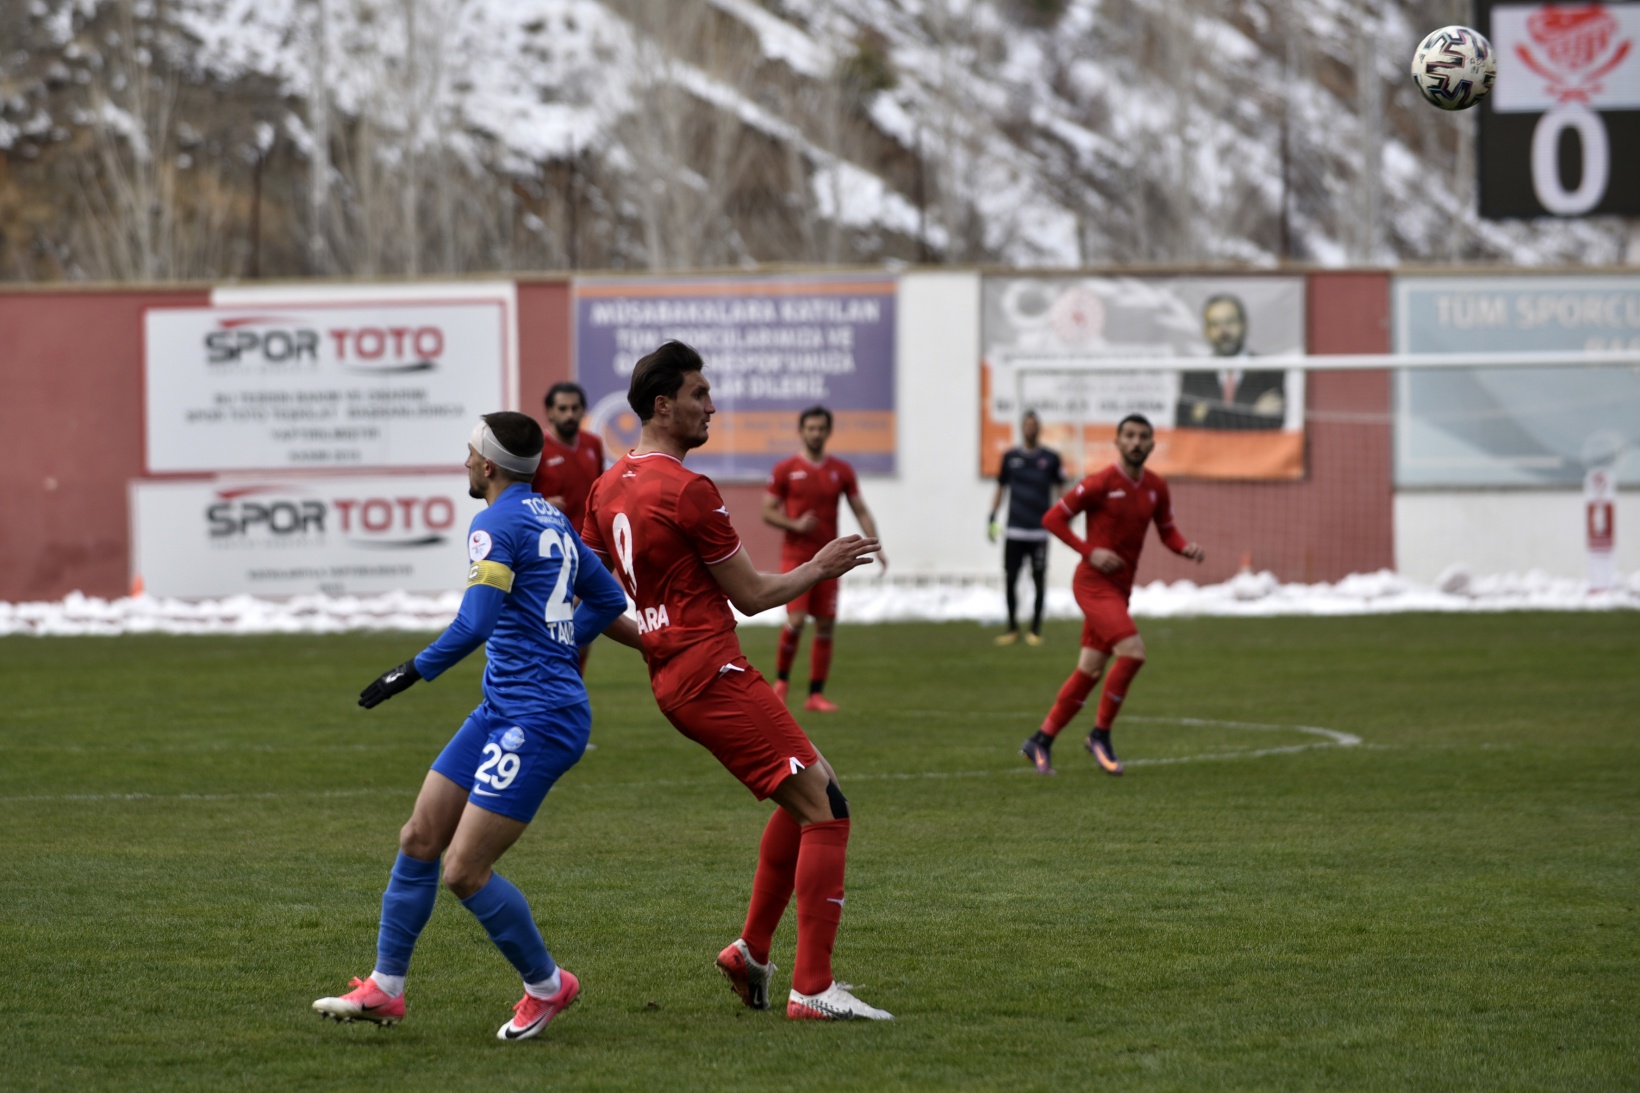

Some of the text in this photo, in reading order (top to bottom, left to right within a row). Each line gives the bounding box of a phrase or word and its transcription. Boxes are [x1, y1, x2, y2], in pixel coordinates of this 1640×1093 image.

[1531, 106, 1609, 216] 0
[205, 325, 444, 363] SPOR TOTO
[206, 496, 455, 537] SPOR TOTO
[474, 742, 521, 790] 29
